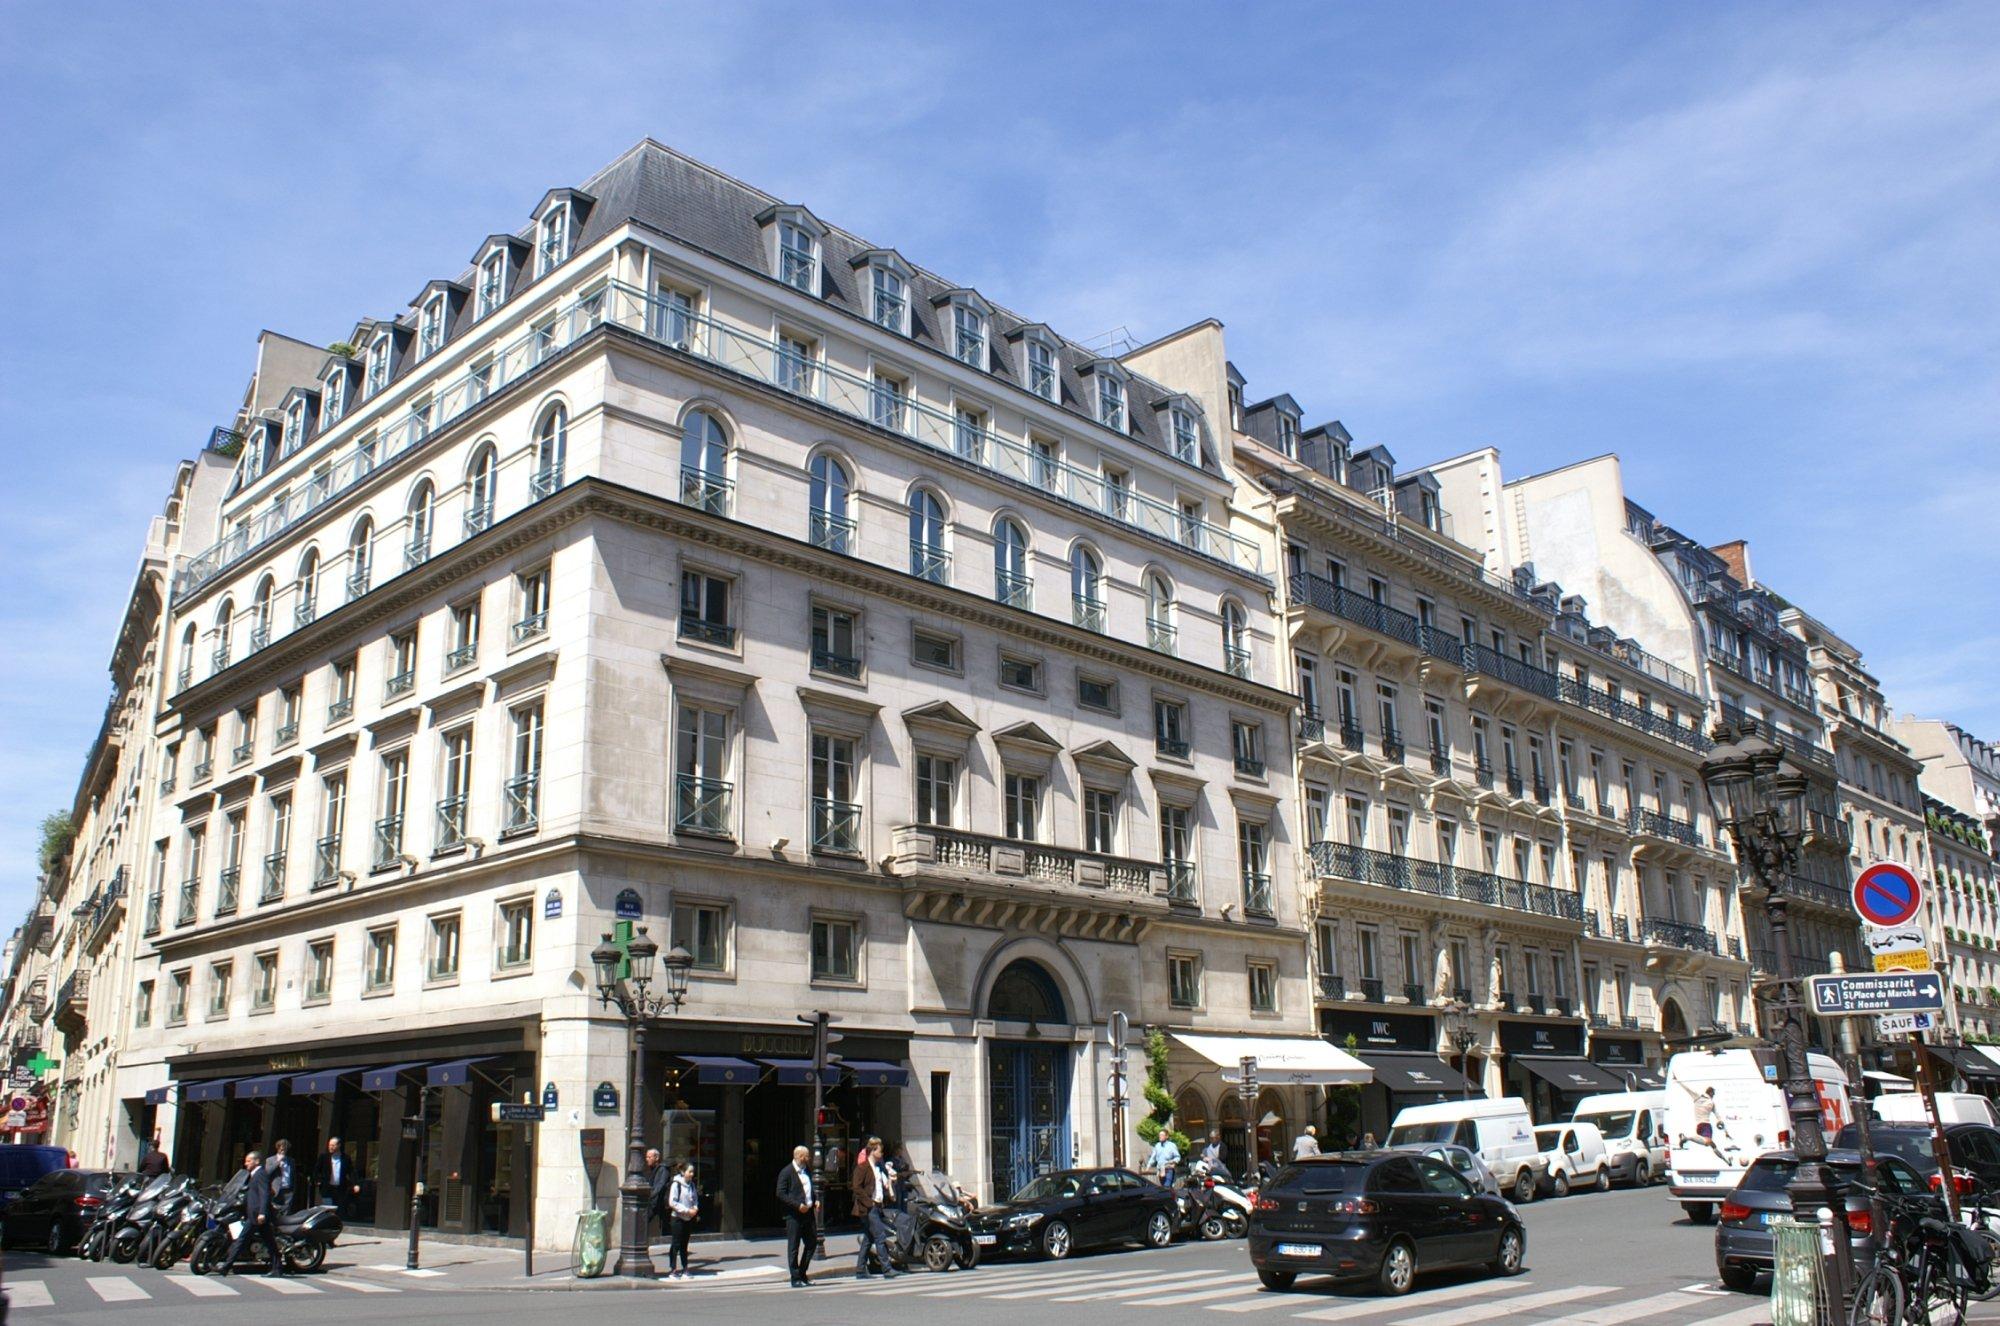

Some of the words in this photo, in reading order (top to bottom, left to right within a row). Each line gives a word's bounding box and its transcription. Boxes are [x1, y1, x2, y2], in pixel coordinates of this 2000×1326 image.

[1841, 978, 1914, 989] Commissariat
[1876, 989, 1886, 998] du
[1887, 988, 1917, 998] Marché
[1844, 1001, 1854, 1009] St
[1857, 999, 1889, 1008] Honoré
[1372, 1021, 1390, 1035] IWC
[1882, 1018, 1912, 1030] SAUF
[1535, 1030, 1549, 1042] IWC
